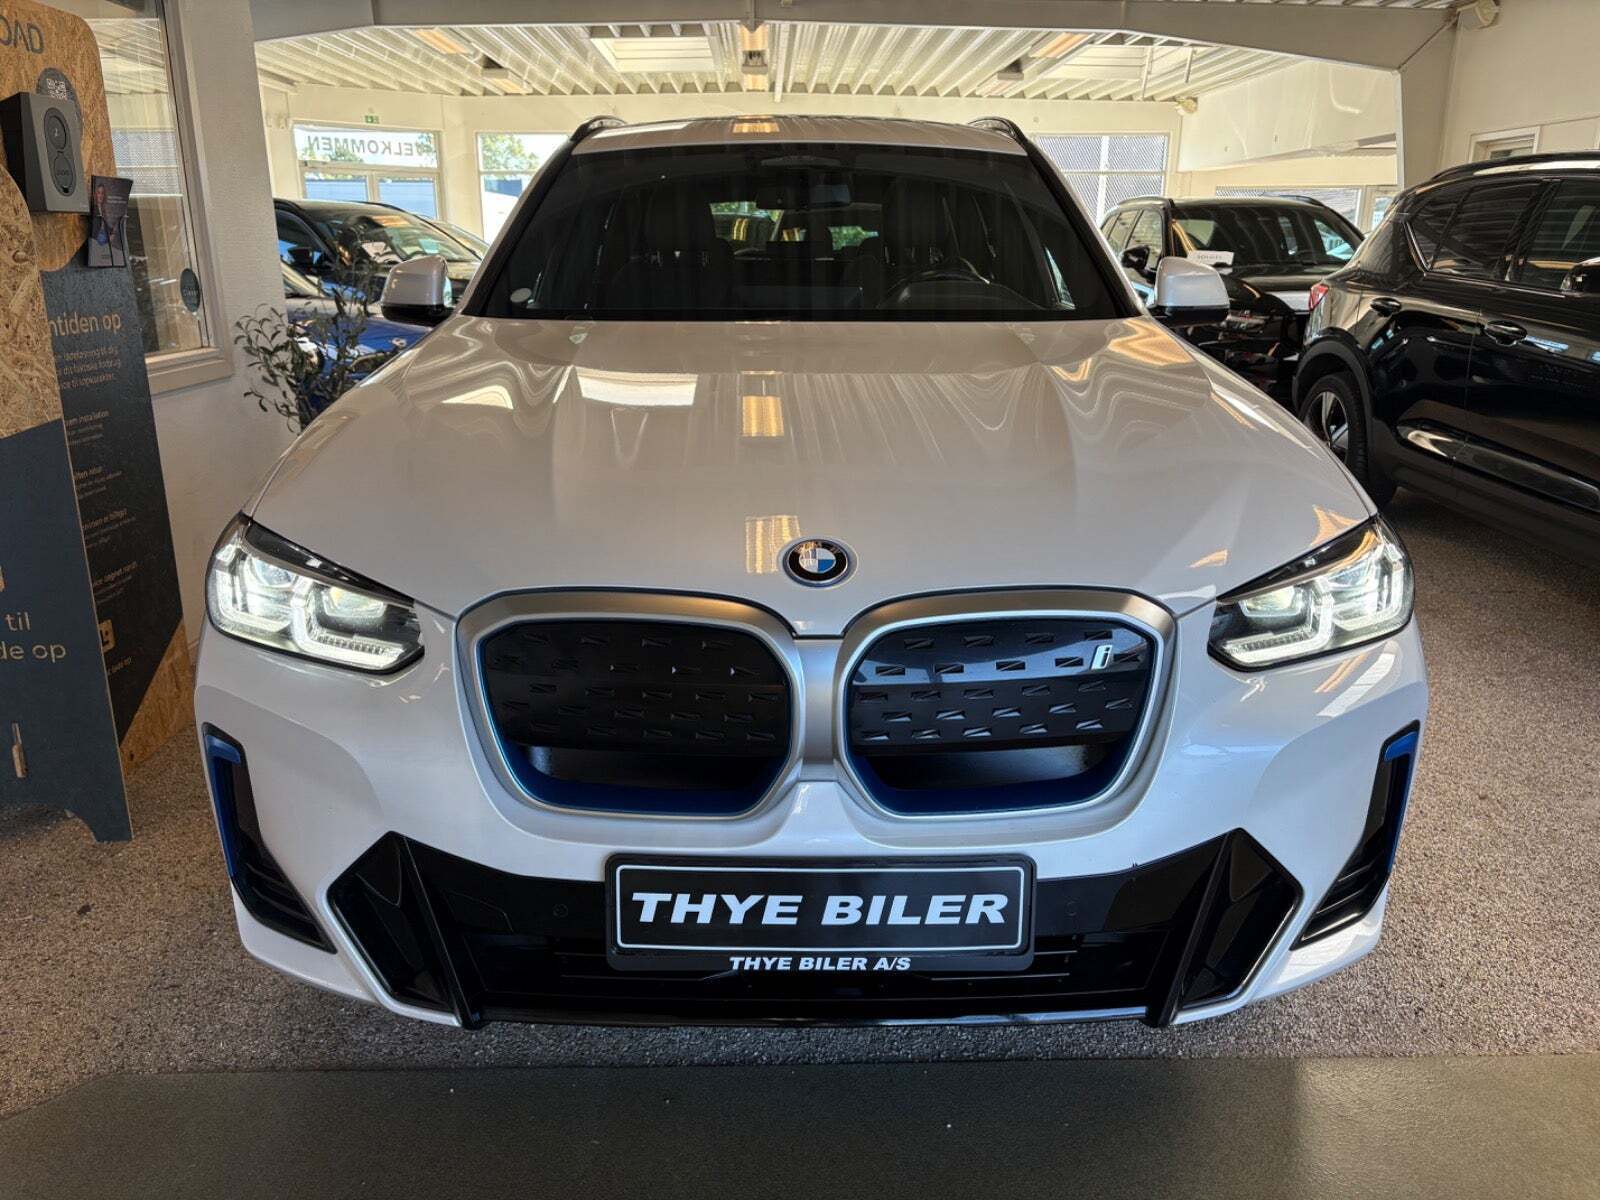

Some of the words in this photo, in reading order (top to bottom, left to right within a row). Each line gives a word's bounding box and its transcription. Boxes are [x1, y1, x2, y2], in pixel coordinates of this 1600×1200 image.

[102, 313, 121, 335] op
[5, 611, 31, 631] til
[32, 644, 66, 663] op
[631, 892, 803, 925] THYE
[820, 893, 1009, 925] BILER
[729, 956, 793, 971] THYE
[798, 956, 868, 971] BILER
[873, 956, 911, 971] A/S
